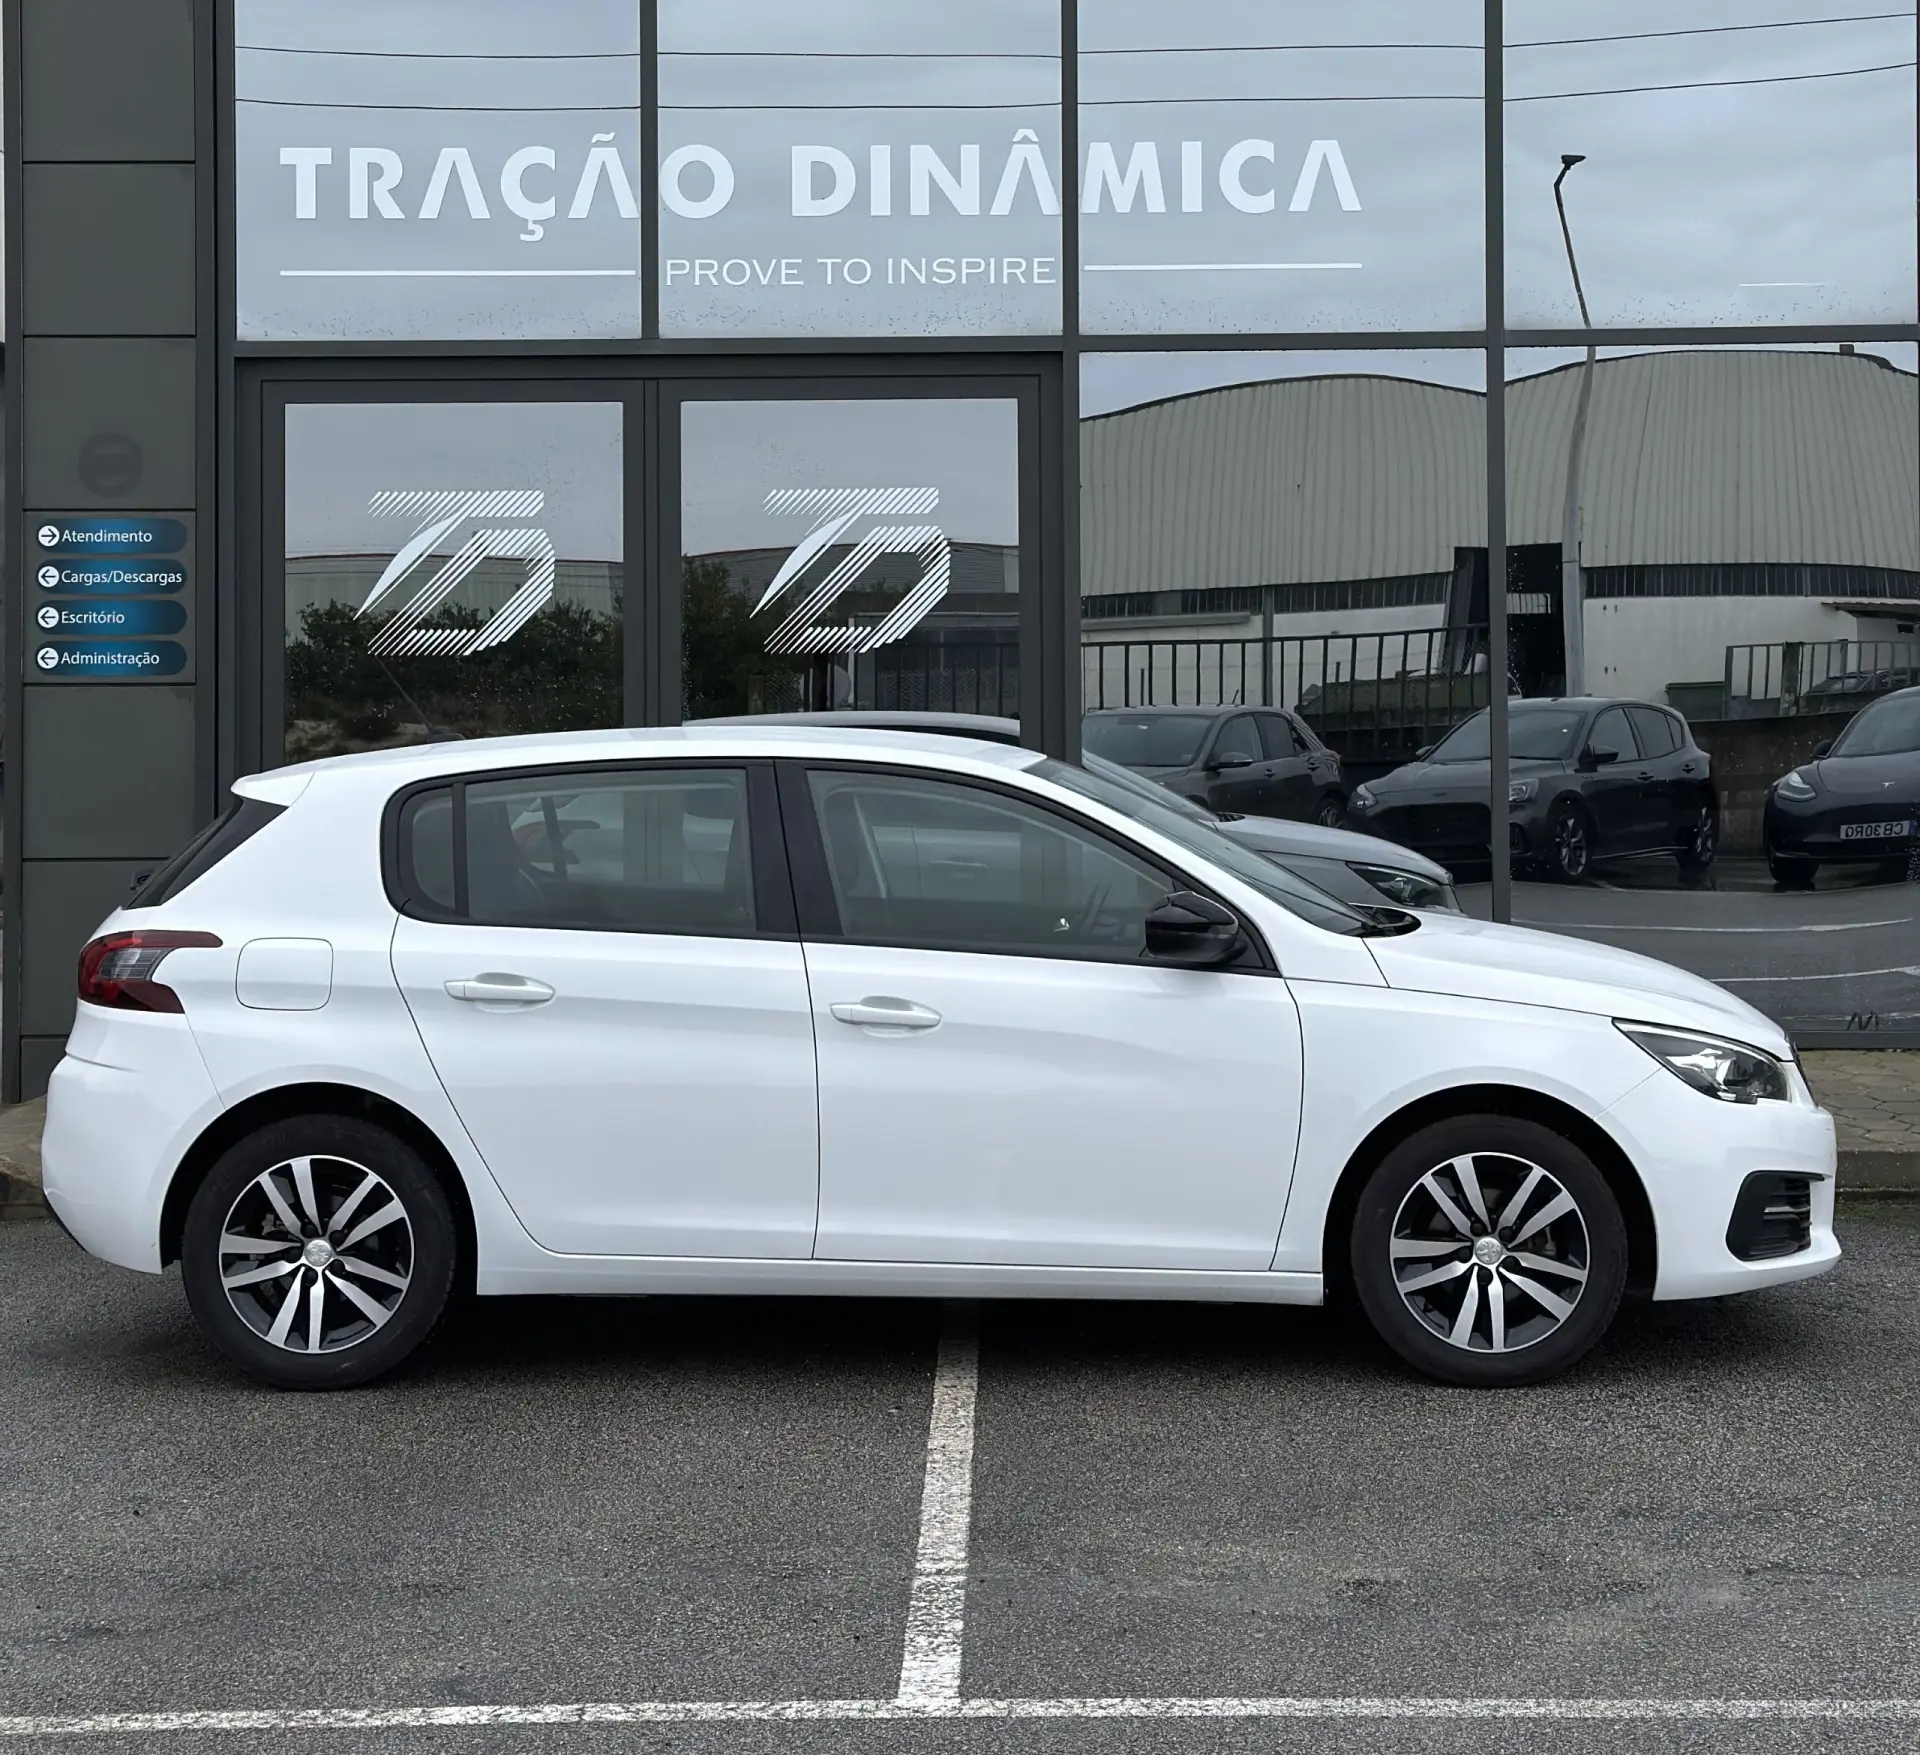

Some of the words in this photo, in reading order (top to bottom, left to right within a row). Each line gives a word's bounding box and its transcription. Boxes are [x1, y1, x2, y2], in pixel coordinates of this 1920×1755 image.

[279, 131, 735, 242] TRAÇÃO
[791, 127, 1363, 217] DINÂMICA
[665, 258, 804, 286] PROVE
[816, 257, 873, 286] TO
[887, 256, 1057, 285] INSPIRE
[61, 529, 153, 543] Atendimento
[61, 570, 183, 586] Cargas/Descargas
[61, 611, 126, 624] Escritório
[60, 651, 160, 668] Administração
